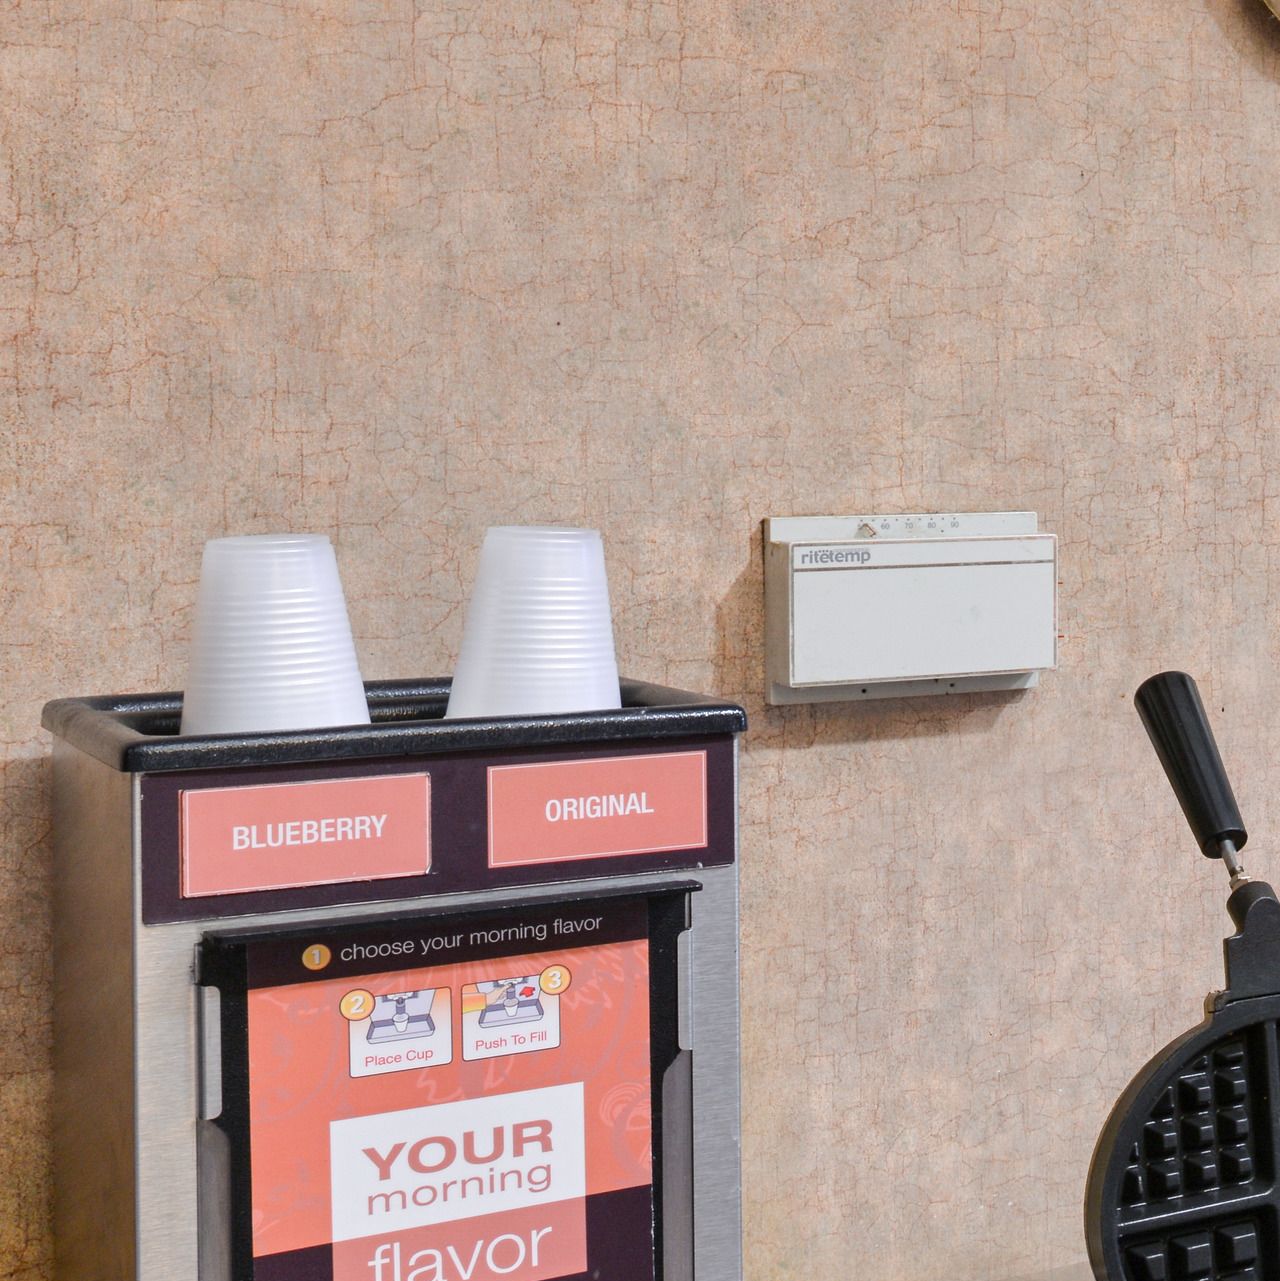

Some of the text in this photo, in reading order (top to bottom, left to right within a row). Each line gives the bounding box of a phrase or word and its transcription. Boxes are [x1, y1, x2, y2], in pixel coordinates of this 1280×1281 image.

[544, 791, 655, 824] ORIGINAL
[231, 813, 389, 851] BLUEBERRY
[340, 940, 415, 962] choose
[420, 935, 464, 956] your
[469, 923, 548, 946] morning
[553, 915, 603, 934] flavor
[547, 970, 563, 990] 3
[350, 995, 365, 1015] 2
[475, 1030, 548, 1051] Push To Fill
[365, 1049, 434, 1067] Place Cup
[361, 1118, 554, 1181] YOUR
[367, 1163, 553, 1216] morning
